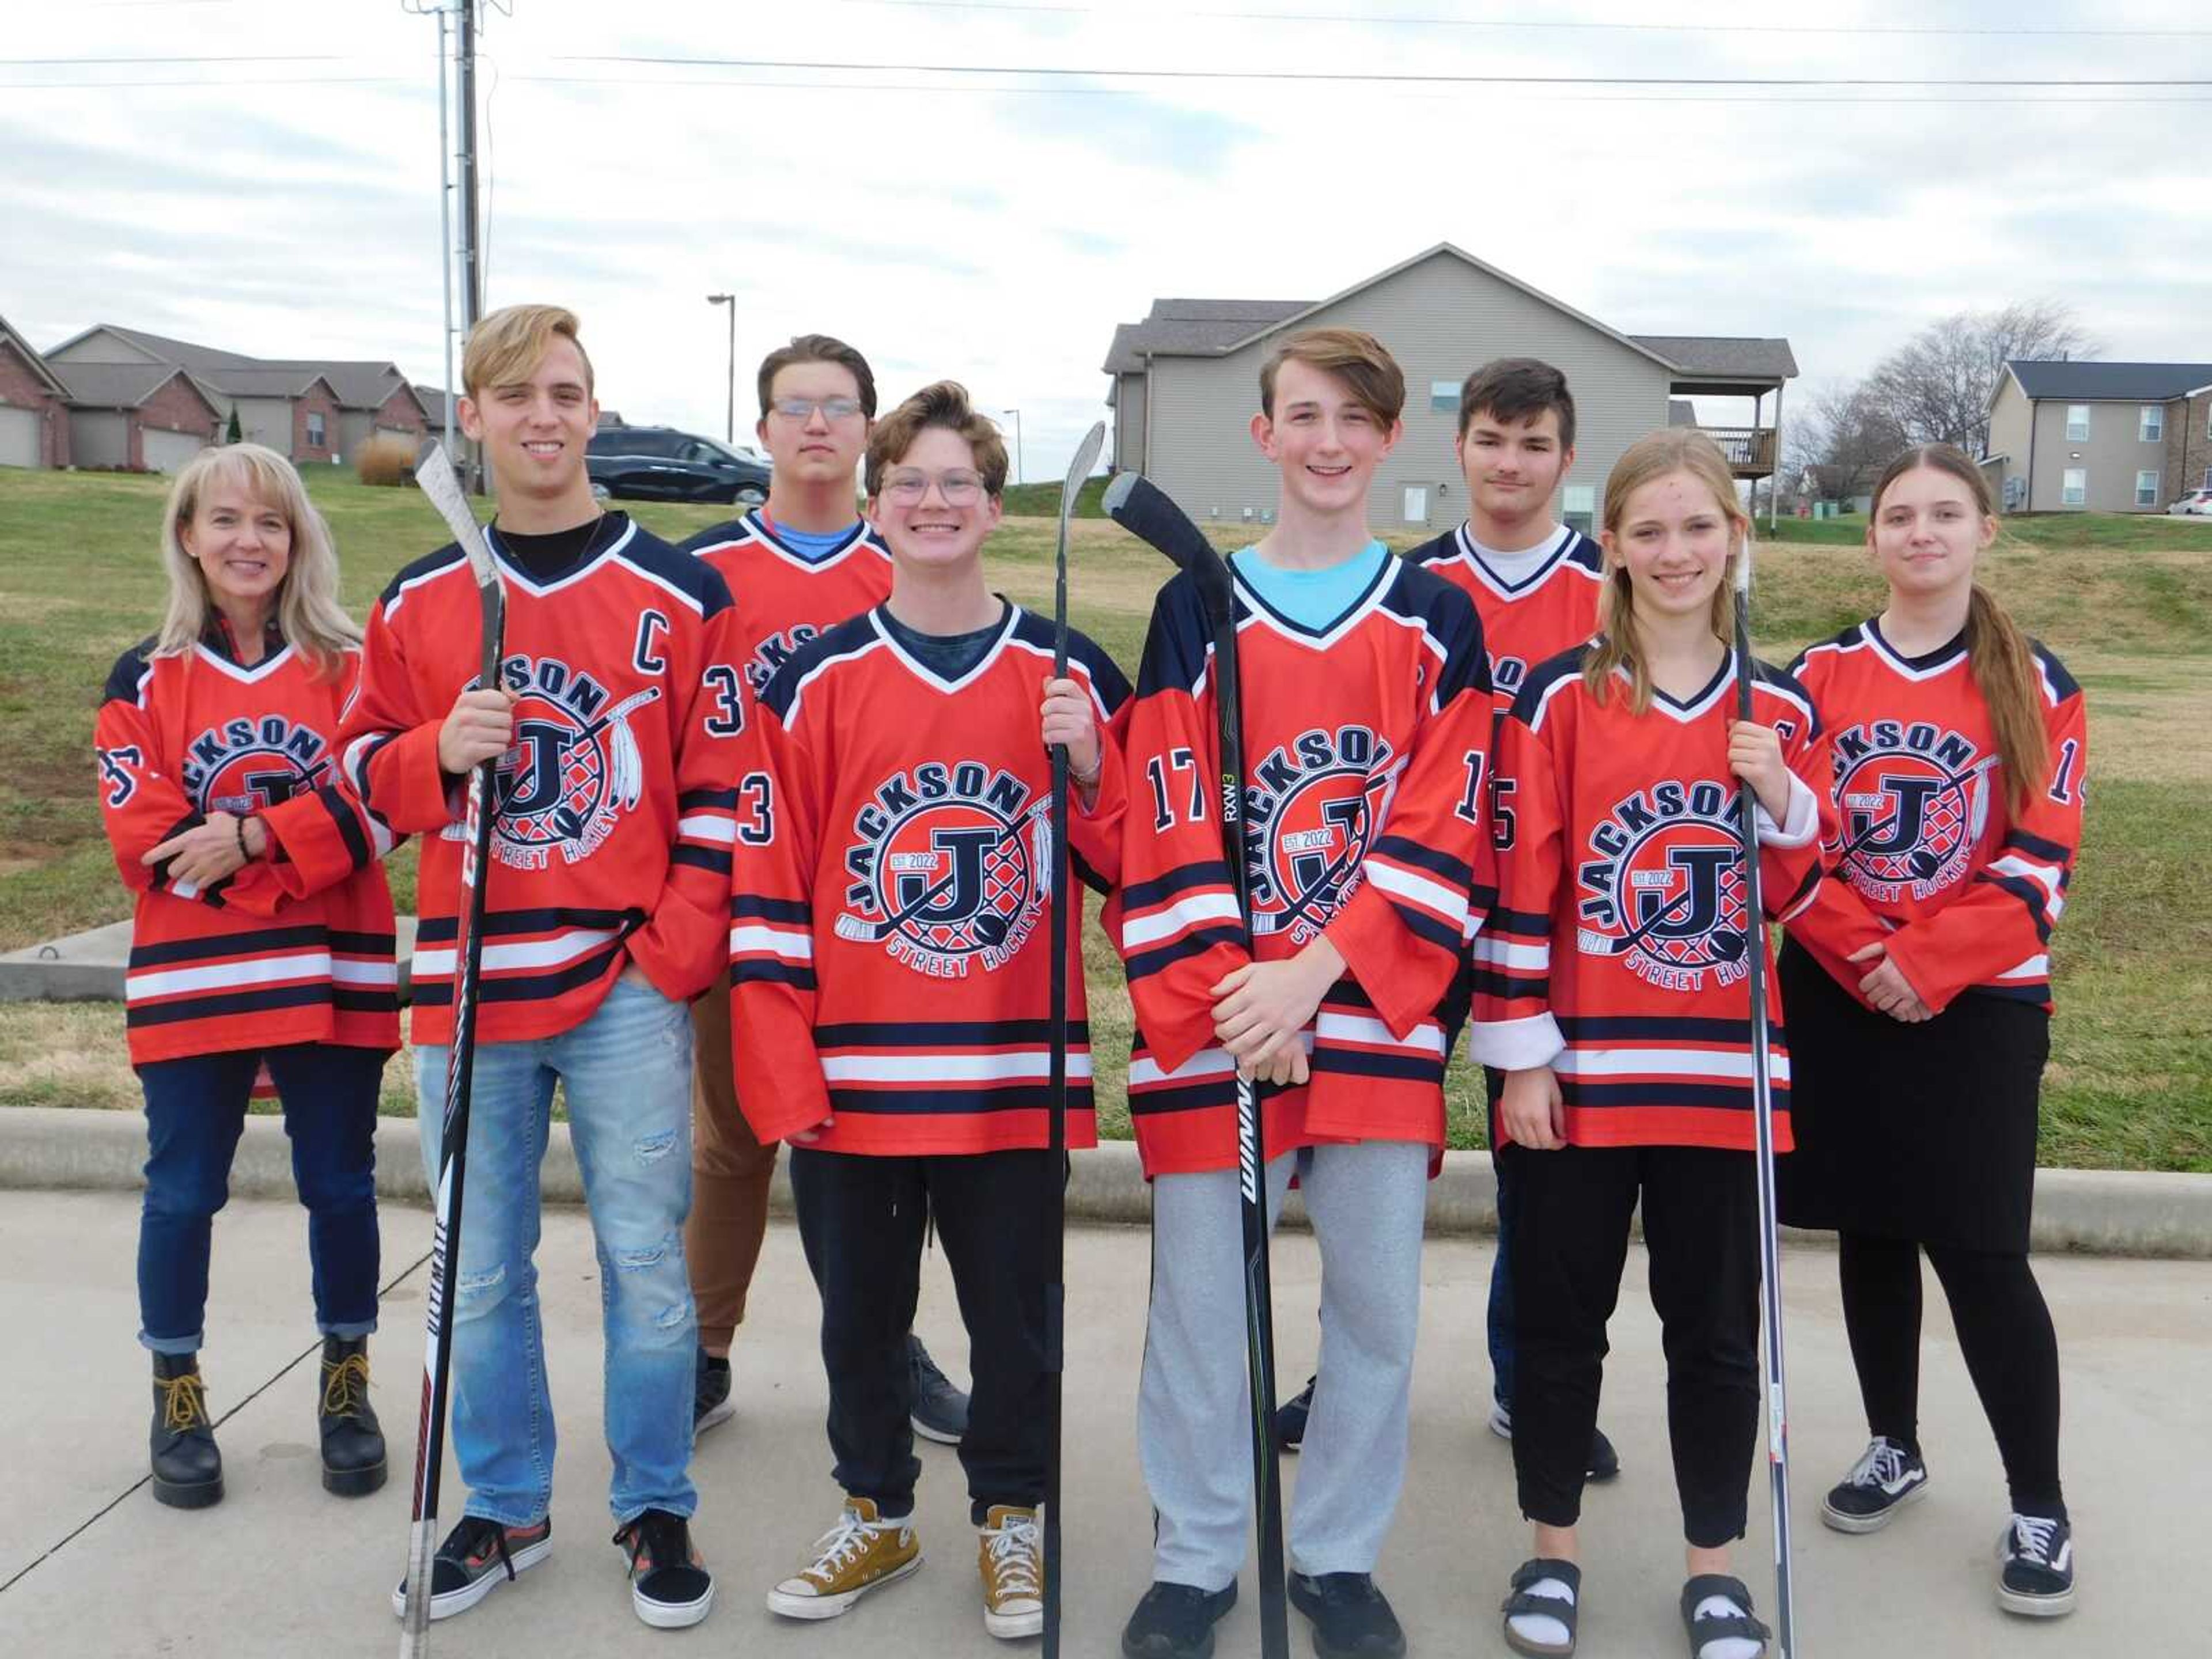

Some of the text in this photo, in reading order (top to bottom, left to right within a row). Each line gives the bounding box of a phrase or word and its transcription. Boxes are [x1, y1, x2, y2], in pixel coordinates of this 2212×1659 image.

[633, 609, 669, 674] C
[703, 665, 744, 737] 3
[183, 715, 325, 795] CKSON
[1834, 720, 1976, 777] KSON
[2047, 737, 2086, 805] 1
[737, 772, 774, 846] 3
[1147, 747, 1206, 833] 17
[1222, 774, 1237, 822] RXW3
[1493, 778, 1516, 851] 5
[1850, 774, 1942, 856] J
[491, 836, 549, 869] REET
[847, 762, 1029, 914] JACKSON
[909, 854, 938, 868] 2022
[897, 827, 1001, 923] J
[1637, 845, 1738, 939] J
[887, 902, 1044, 979] STREET HOCKEY
[1625, 951, 1703, 991] STREET
[426, 1217, 447, 1338] ULTIMATE
